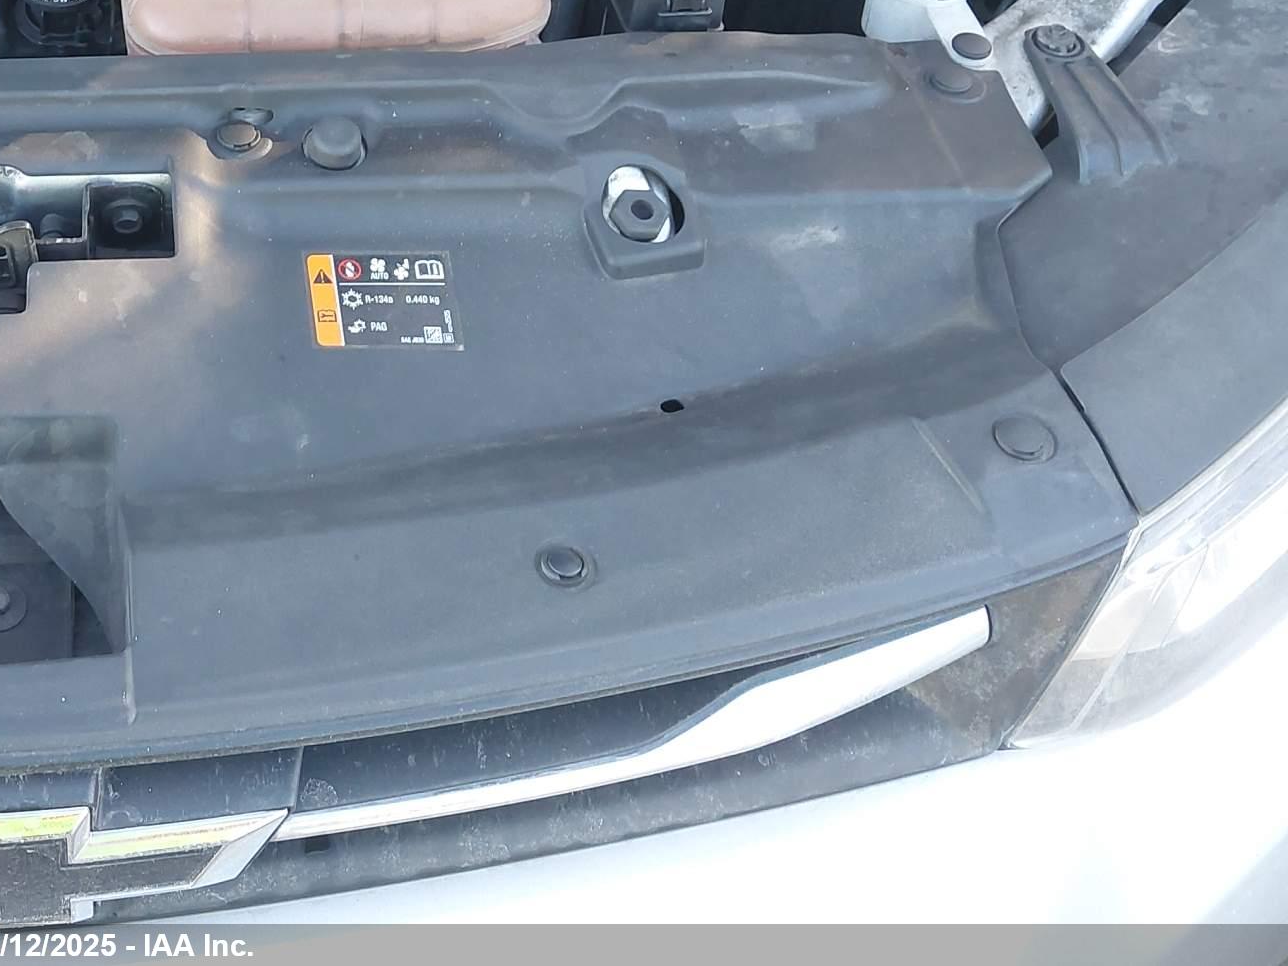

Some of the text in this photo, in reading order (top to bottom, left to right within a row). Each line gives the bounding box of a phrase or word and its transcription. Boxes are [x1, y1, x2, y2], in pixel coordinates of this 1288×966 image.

[370, 272, 390, 280] AUTO
[405, 295, 428, 304] 0.440
[429, 295, 440, 306] kg
